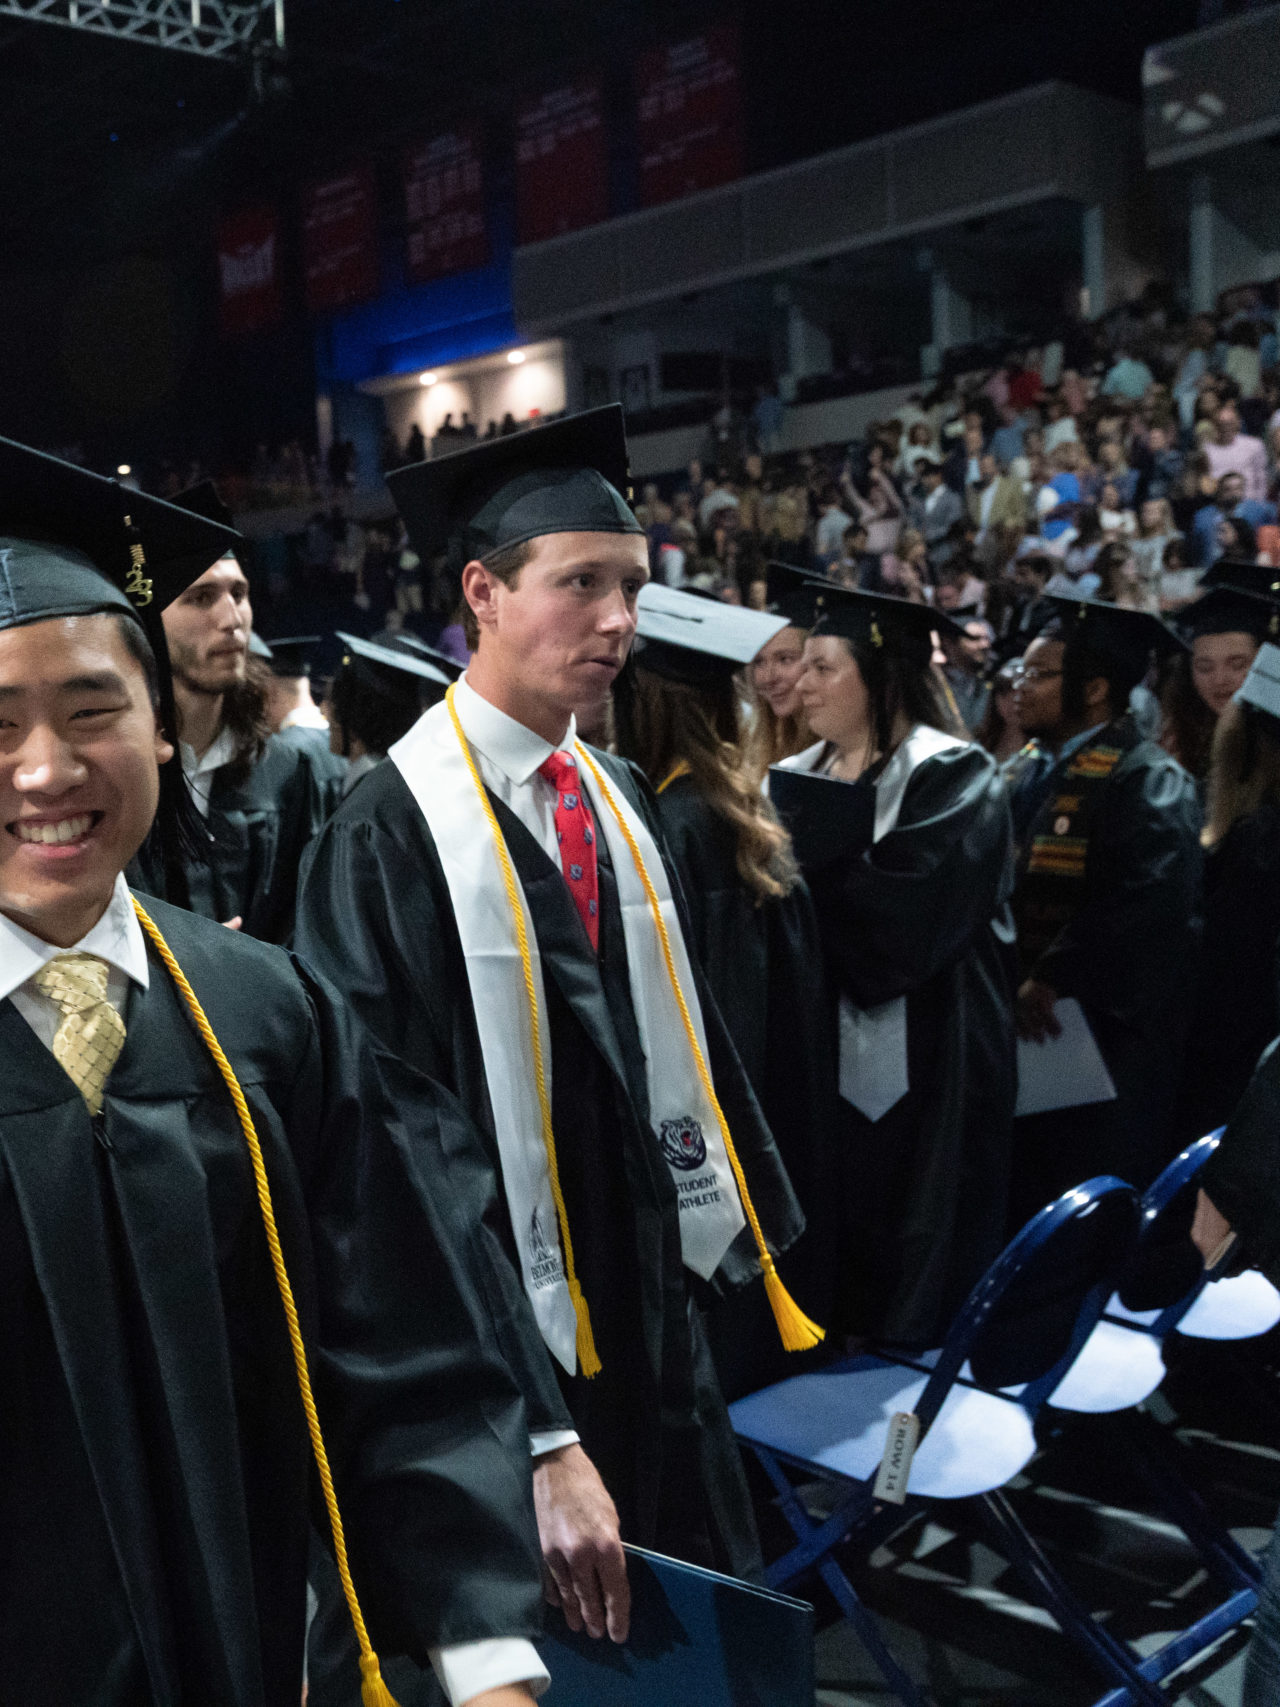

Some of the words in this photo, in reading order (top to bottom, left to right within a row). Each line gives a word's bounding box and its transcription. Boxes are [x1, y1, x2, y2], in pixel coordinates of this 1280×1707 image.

[125, 570, 154, 607] 23
[679, 1190, 721, 1211] ATHLETE
[890, 1428, 907, 1470] ROW
